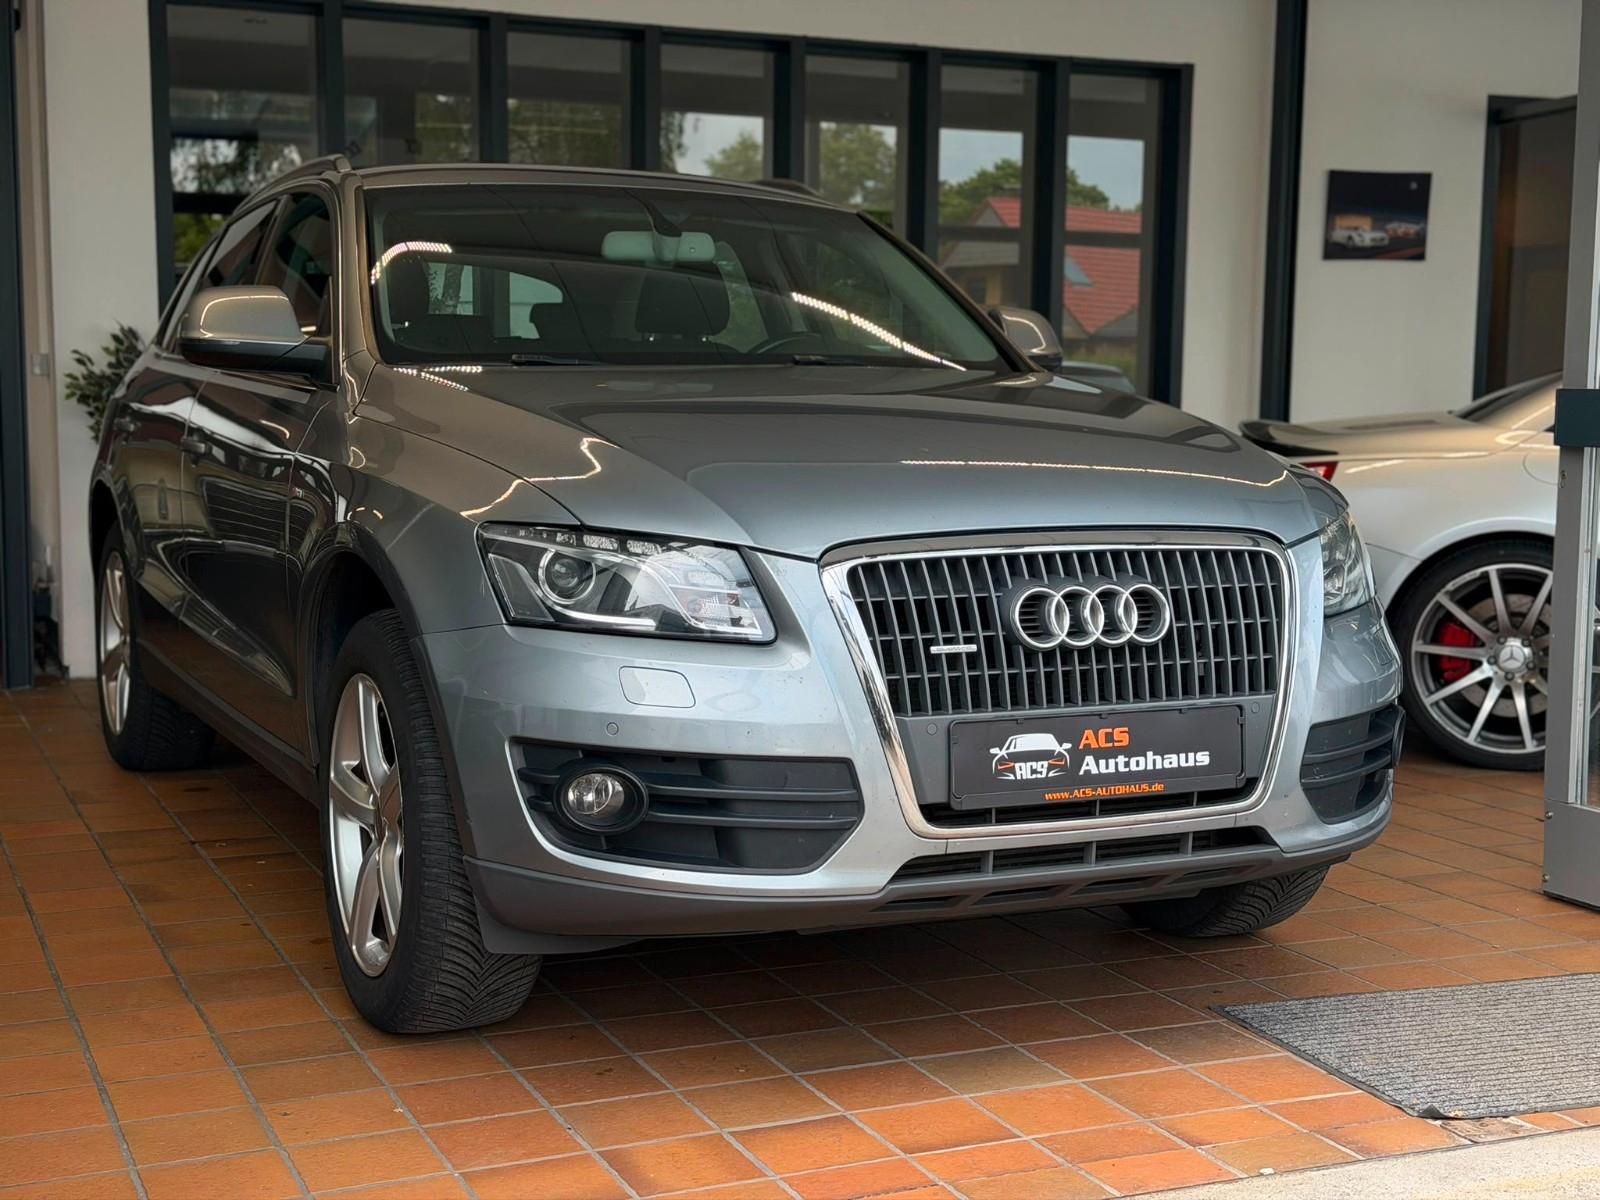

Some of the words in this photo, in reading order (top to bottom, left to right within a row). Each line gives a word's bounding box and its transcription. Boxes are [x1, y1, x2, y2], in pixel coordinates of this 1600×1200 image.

[1079, 727, 1129, 749] ACS
[1079, 751, 1211, 775] Autohaus
[1044, 783, 1164, 800] www.ACS-AUTOHAUS.de
